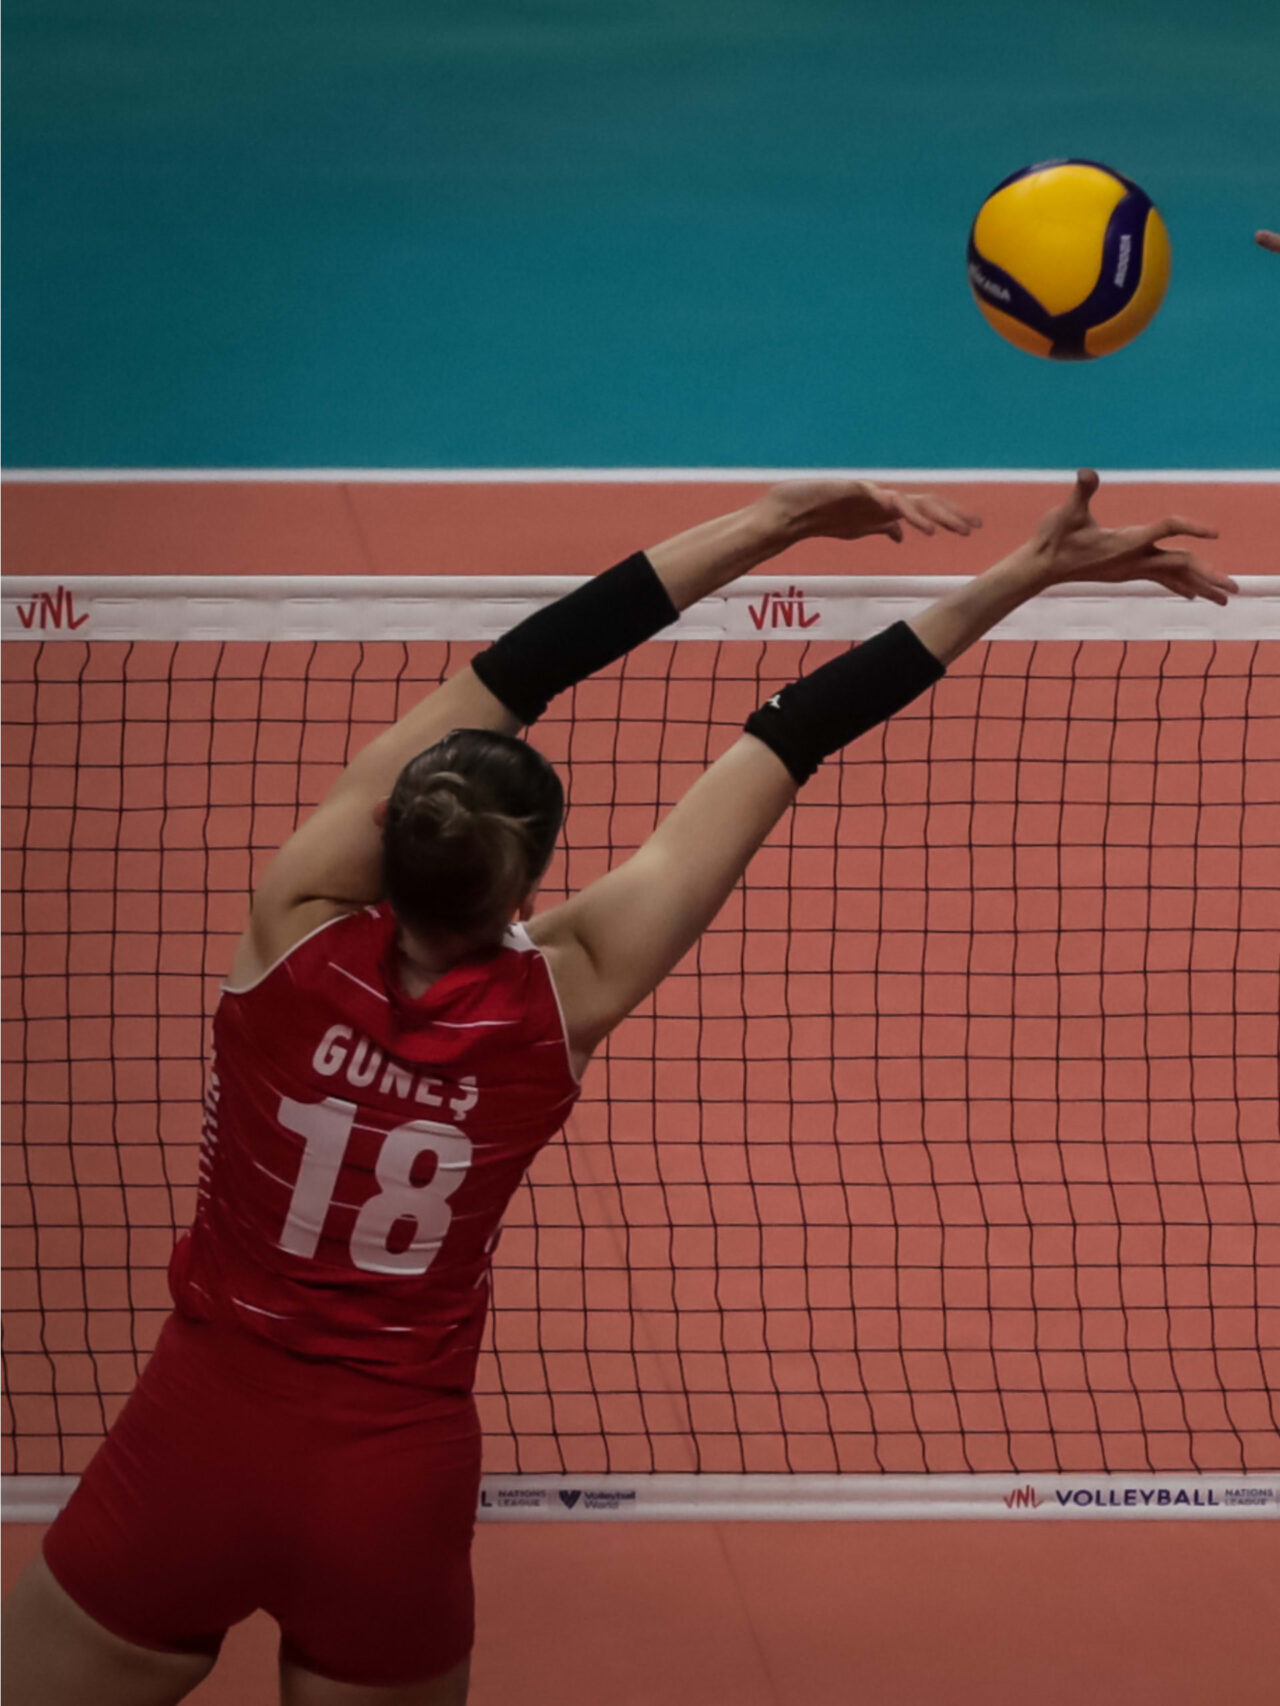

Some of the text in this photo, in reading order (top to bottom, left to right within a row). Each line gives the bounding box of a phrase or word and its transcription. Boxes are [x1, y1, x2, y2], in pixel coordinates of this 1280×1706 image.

[17, 585, 89, 630] VNL
[748, 585, 821, 630] VNL
[277, 1096, 473, 1275] 18
[498, 1490, 546, 1498] NATIONS
[1003, 1485, 1219, 1508] VNL VOLLEYBALL
[1225, 1489, 1273, 1497] NATIONS
[498, 1499, 540, 1507] LEAGUE
[1225, 1498, 1266, 1506] LEAGUE
